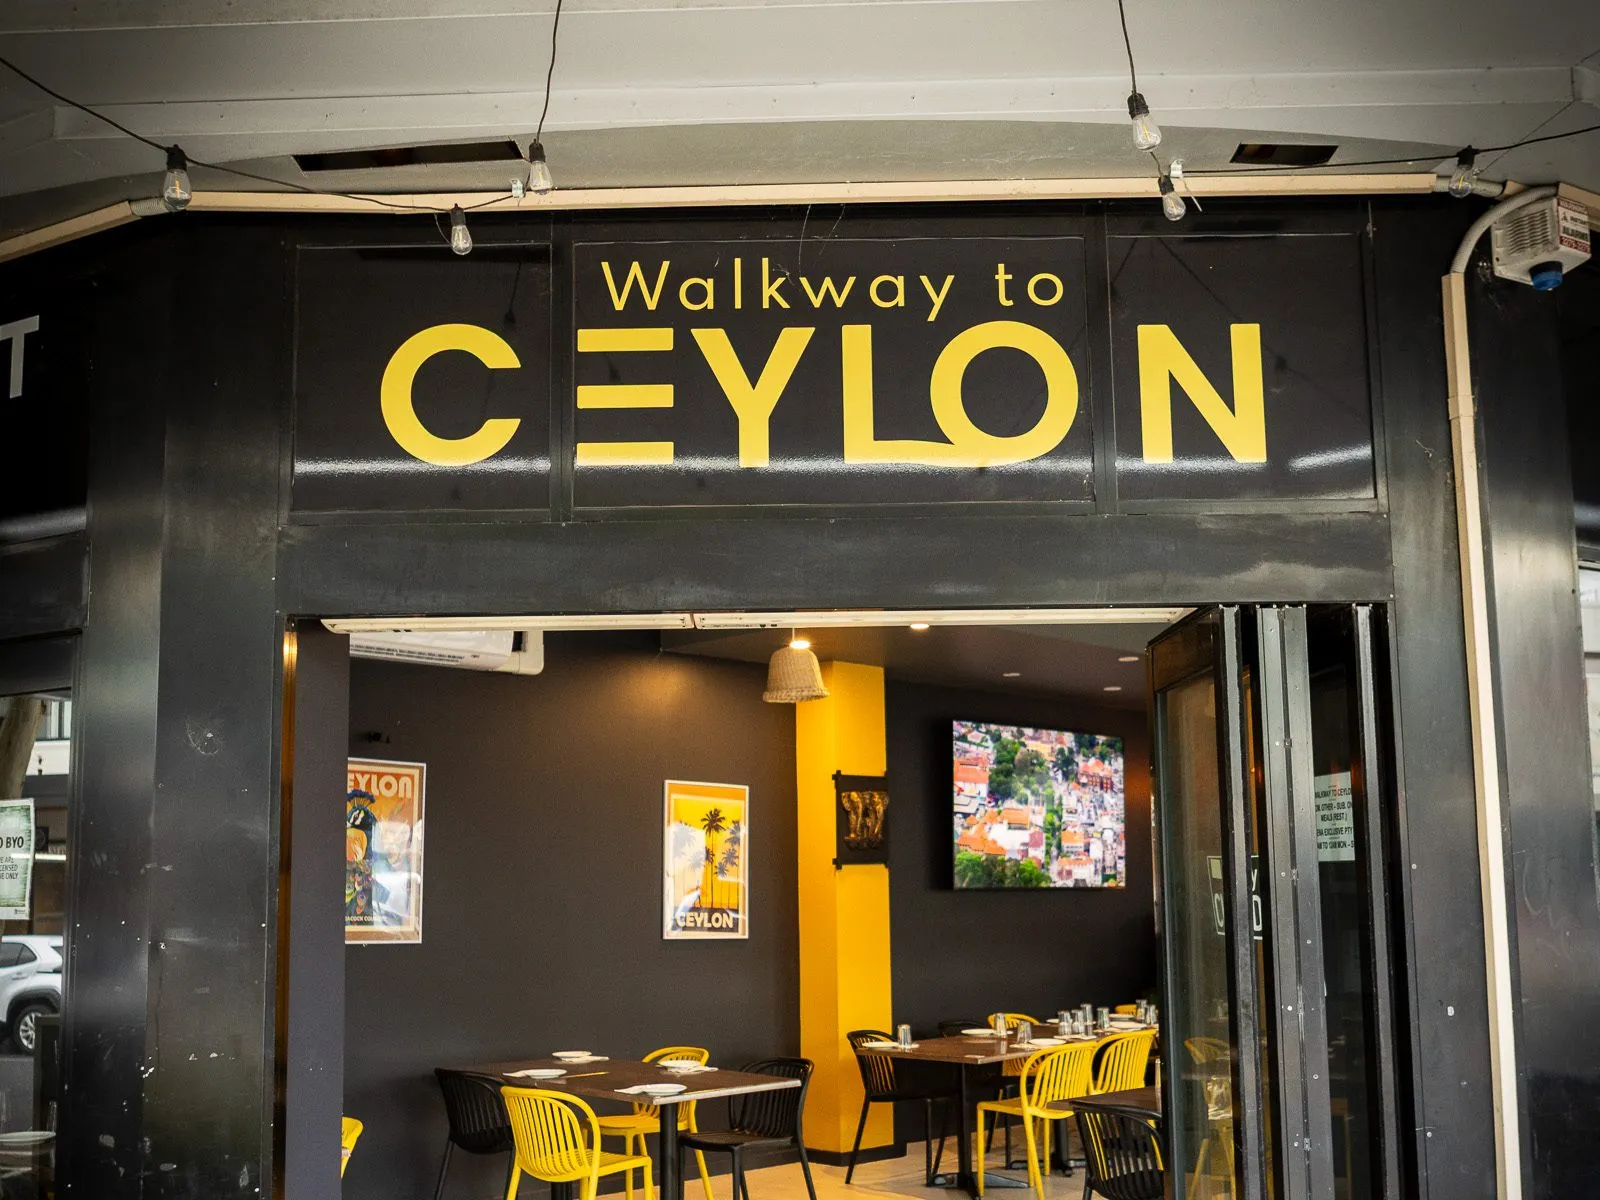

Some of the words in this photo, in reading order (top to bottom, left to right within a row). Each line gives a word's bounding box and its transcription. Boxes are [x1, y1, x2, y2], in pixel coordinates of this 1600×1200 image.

[601, 258, 955, 321] Walkway
[995, 263, 1064, 307] to
[380, 320, 1267, 468] CEYLON
[1324, 827, 1344, 836] EXCLUSIVE
[6, 836, 24, 848] BYO
[676, 911, 733, 928] CEYLON
